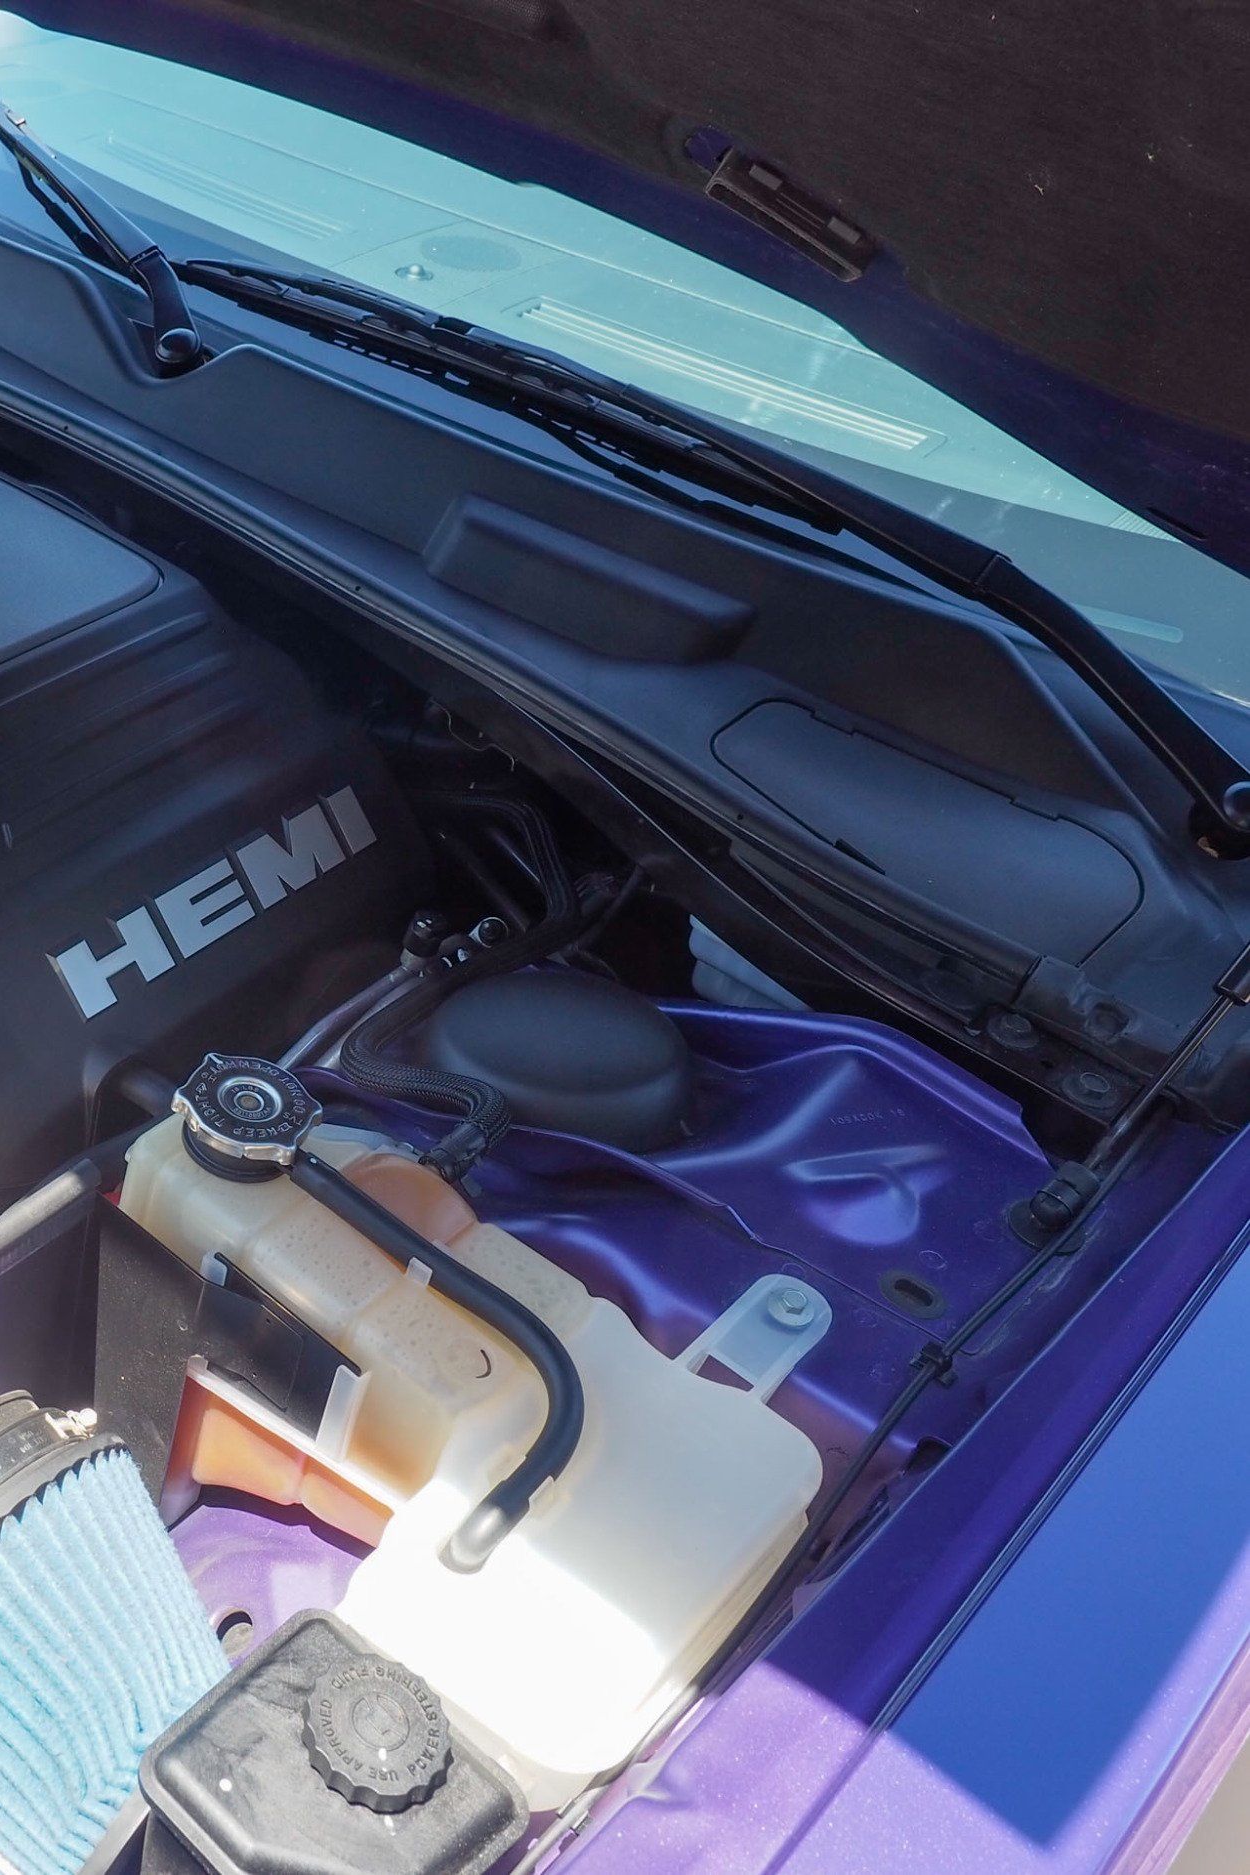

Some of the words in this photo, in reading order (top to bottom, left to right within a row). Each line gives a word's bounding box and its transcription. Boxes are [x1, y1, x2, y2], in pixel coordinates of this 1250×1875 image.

[45, 785, 377, 1022] HEMI
[331, 1666, 370, 1690] FLUID
[375, 1665, 439, 1722] STEERING
[319, 1699, 364, 1771] APPROVED
[406, 1727, 440, 1777] POWER
[368, 1766, 400, 1782] USE
